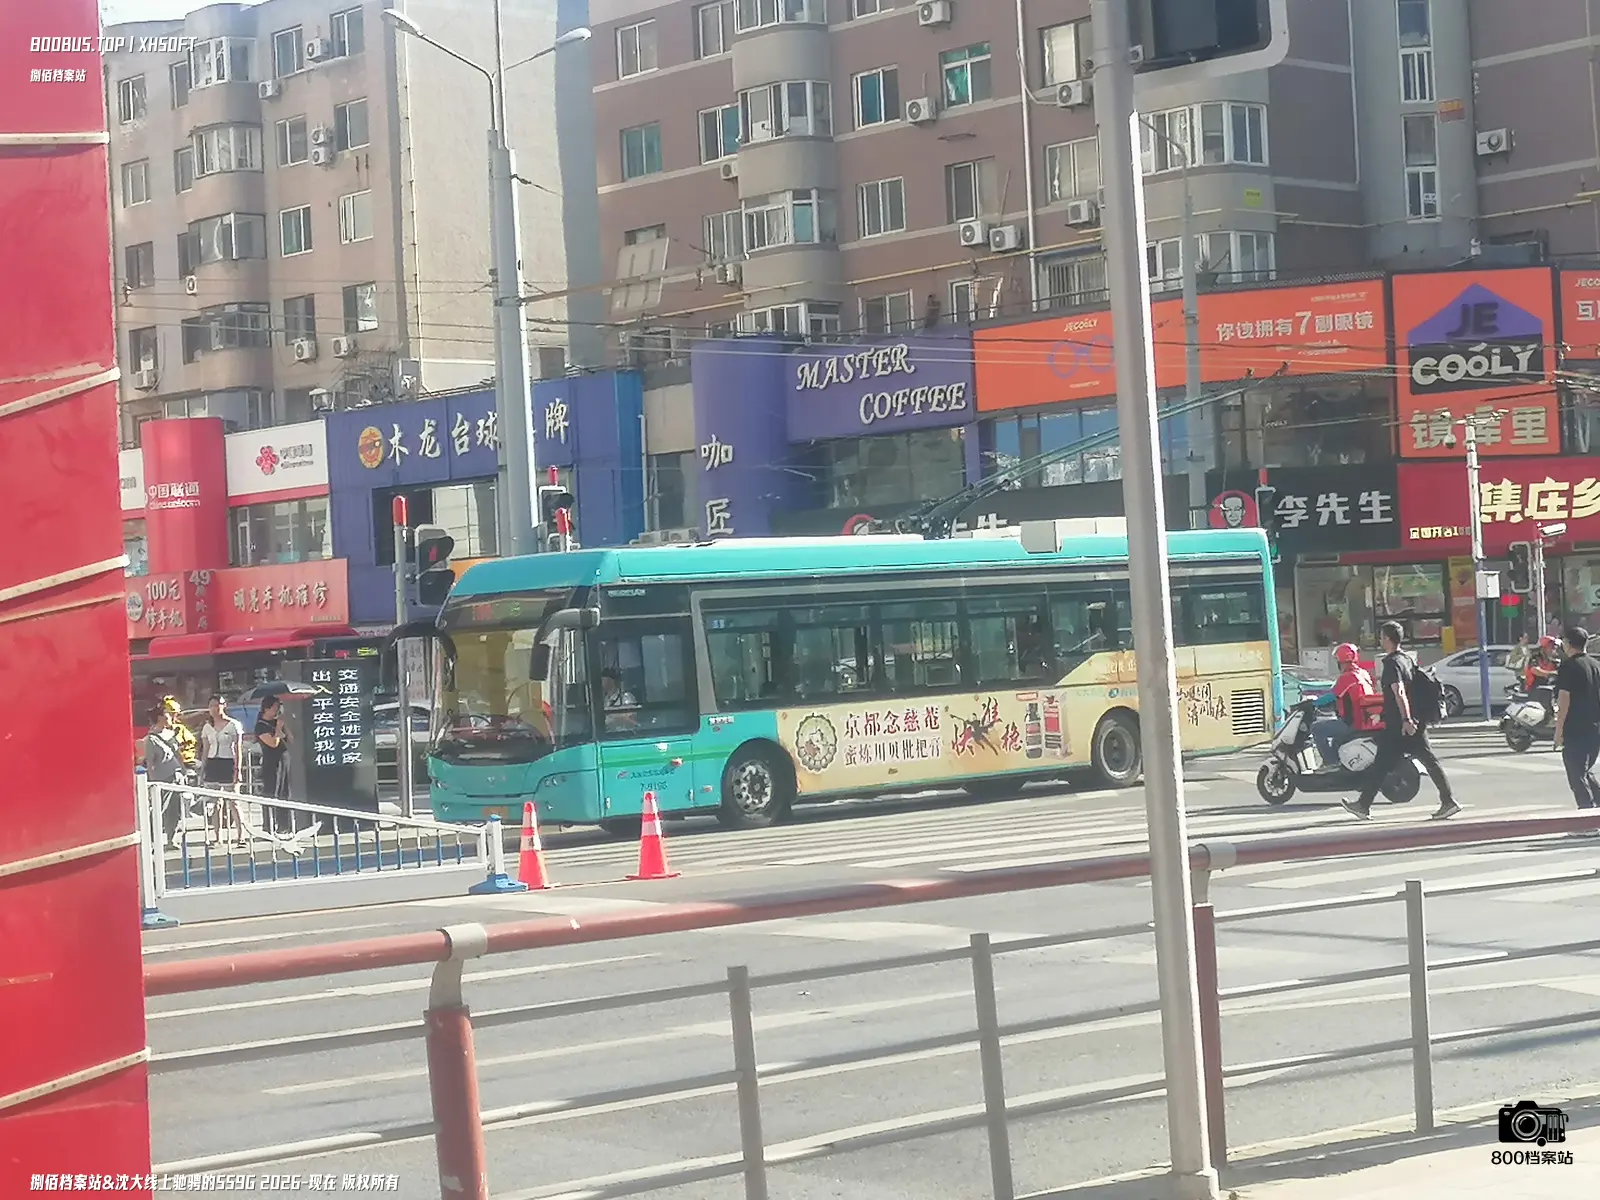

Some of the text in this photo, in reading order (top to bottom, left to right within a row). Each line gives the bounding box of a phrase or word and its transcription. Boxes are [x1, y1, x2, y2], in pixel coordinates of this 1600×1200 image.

[1216, 310, 1374, 342] 你该拥有7副眼镜
[1446, 302, 1500, 337] JE
[1576, 300, 1600, 321] 互
[796, 343, 915, 391] MASTER
[1411, 341, 1538, 386] COOLY
[859, 382, 966, 425] COFFEE
[387, 397, 570, 467] 木龙台球牌
[701, 433, 734, 536] 咖匠
[1274, 490, 1393, 528] 李先生
[145, 579, 181, 602] 100元
[189, 570, 211, 586] 49
[233, 581, 328, 613] 明亮手机维修
[145, 607, 184, 631] 修手机
[312, 670, 336, 766] 出入平安你我他
[338, 669, 362, 764] 交通安全进万家
